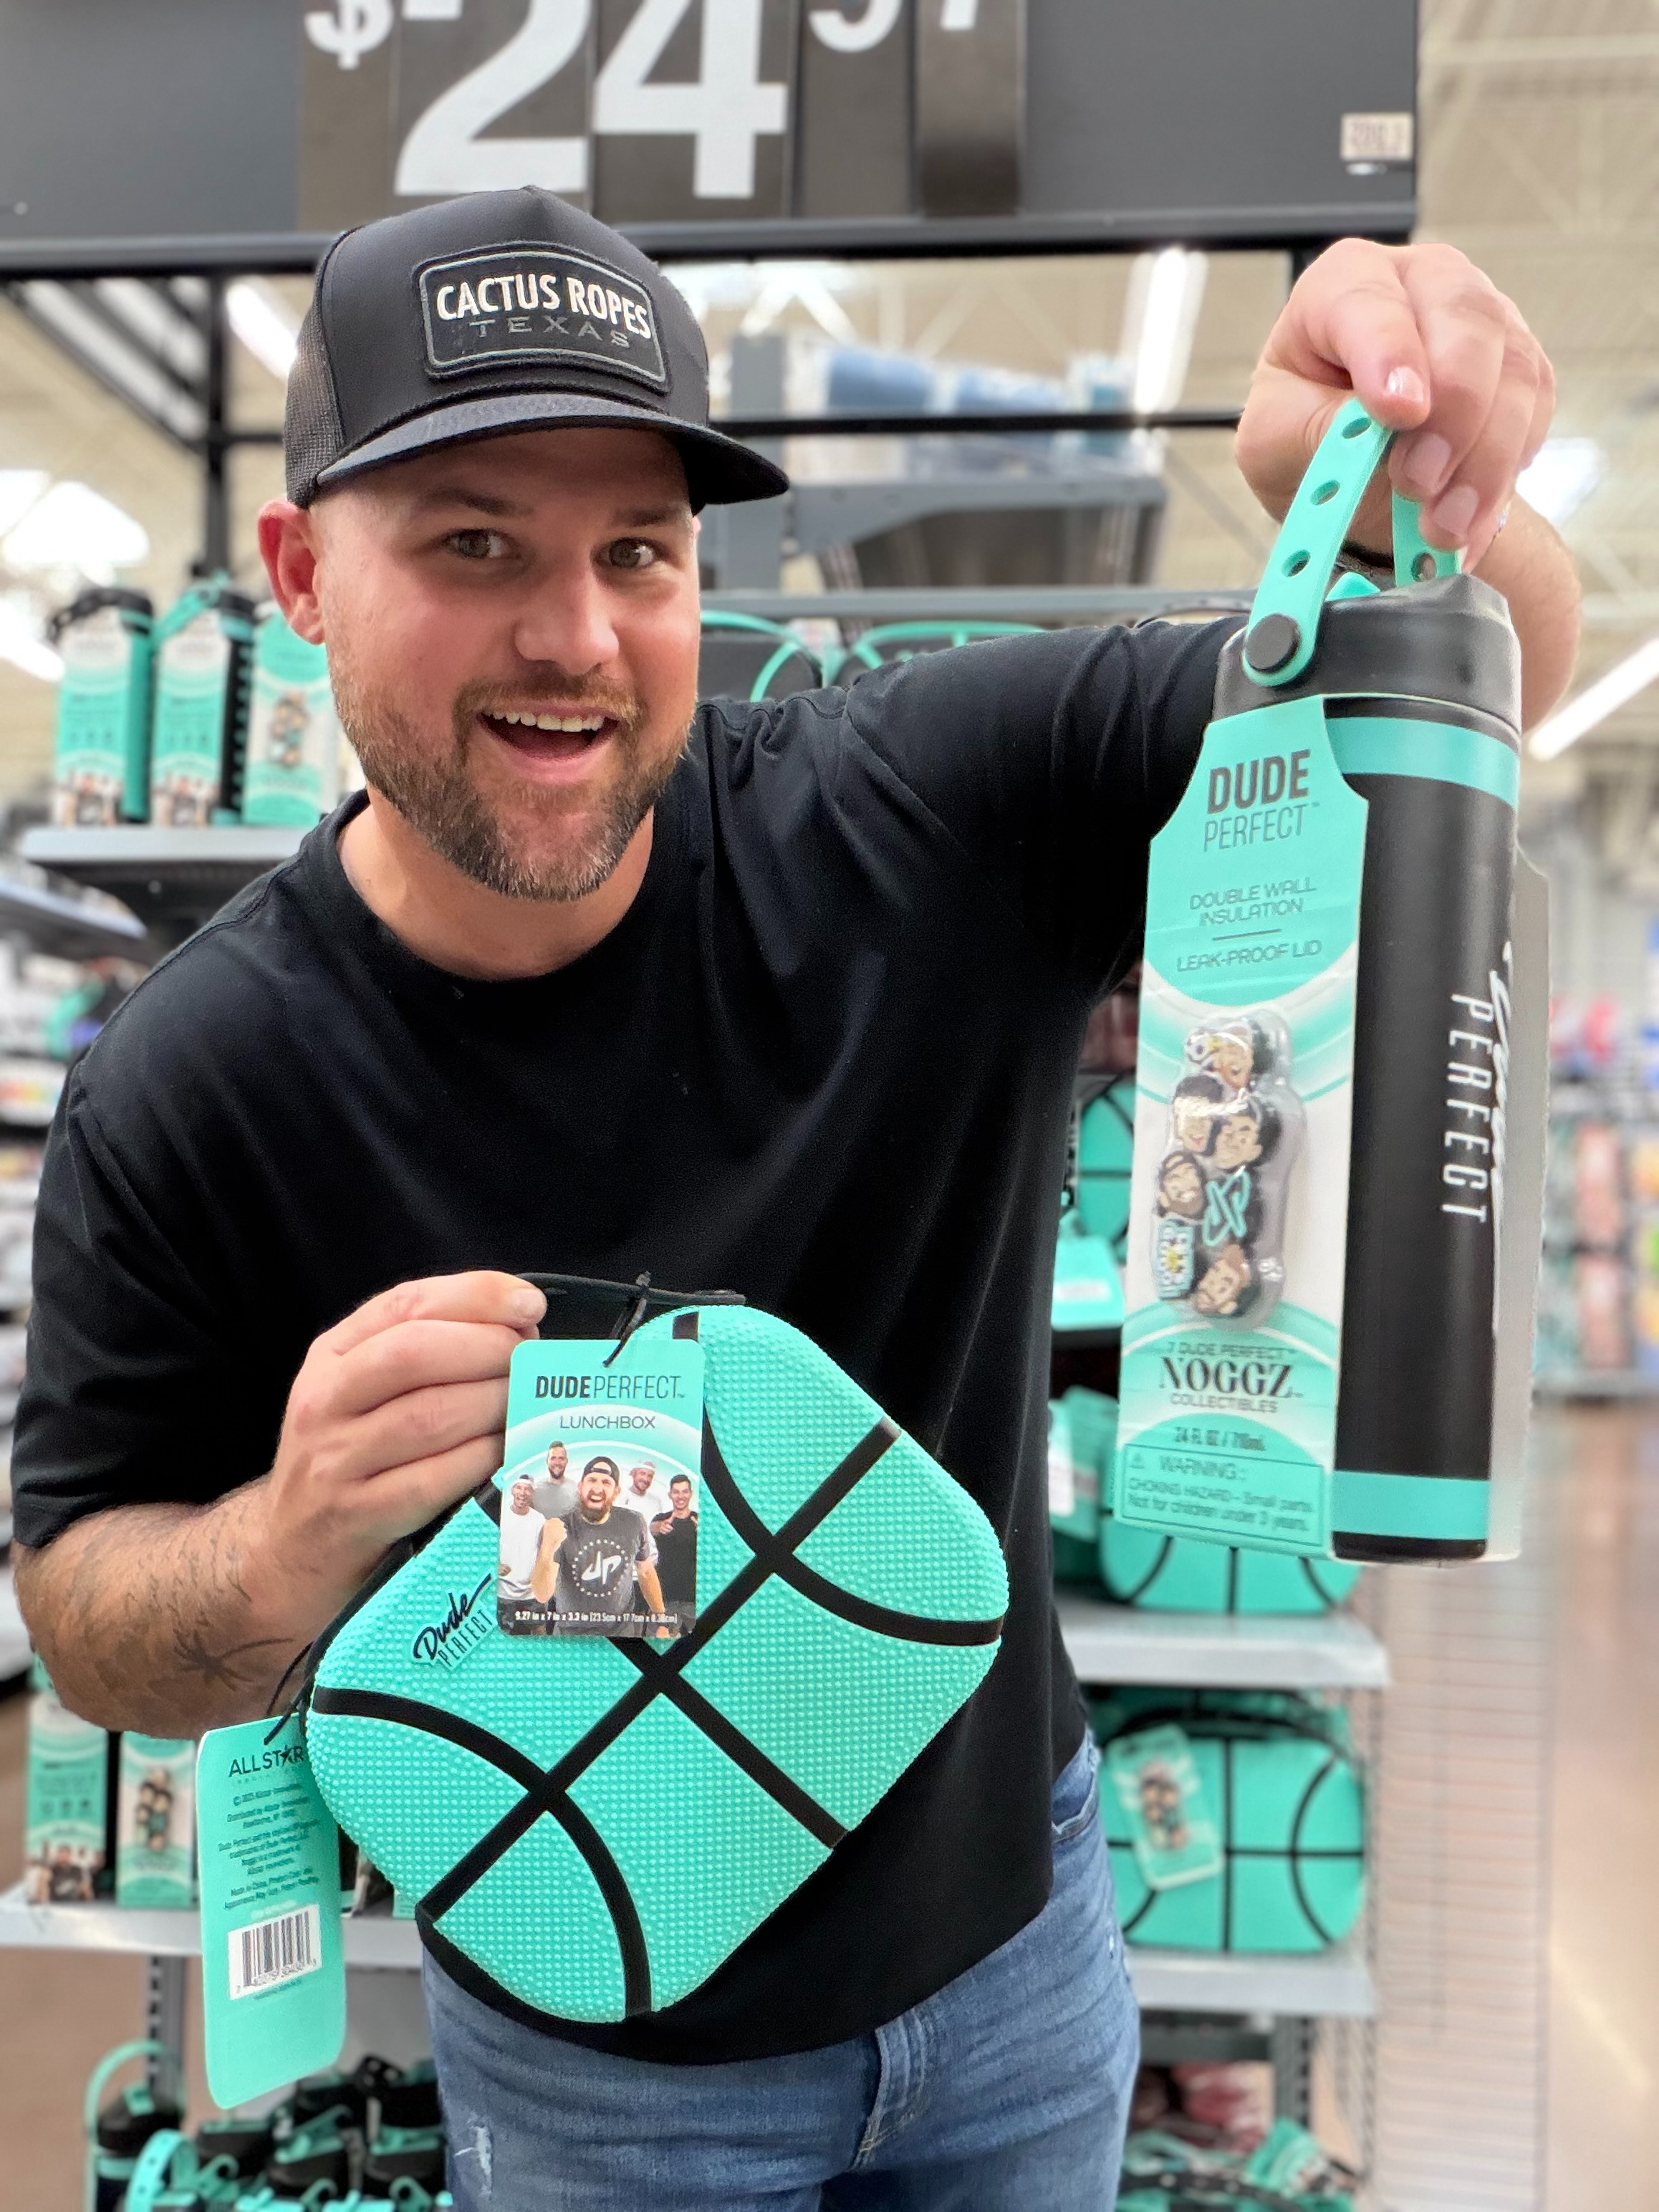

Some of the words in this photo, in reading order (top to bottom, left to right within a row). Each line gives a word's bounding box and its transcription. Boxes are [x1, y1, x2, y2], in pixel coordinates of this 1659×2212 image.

[436, 273, 561, 321] CACTUS
[566, 276, 652, 340] ROPES
[468, 315, 631, 349] TEXAS
[1207, 749, 1311, 815] DUDE
[1190, 885, 1261, 910] DOUBLE
[1264, 877, 1317, 898] WALL
[1199, 898, 1304, 926] INSULATION
[1177, 943, 1290, 973] LEAK-PROOF
[1292, 940, 1323, 958] LID
[1440, 993, 1495, 1223] PERFECT
[1158, 1357, 1292, 1398] NOGGZ
[1169, 1393, 1278, 1413] COLLECTIBLES
[559, 1415, 656, 1430] LUNCHBOX
[413, 1573, 492, 1660] Dude
[438, 1609, 493, 1667] PERFECT
